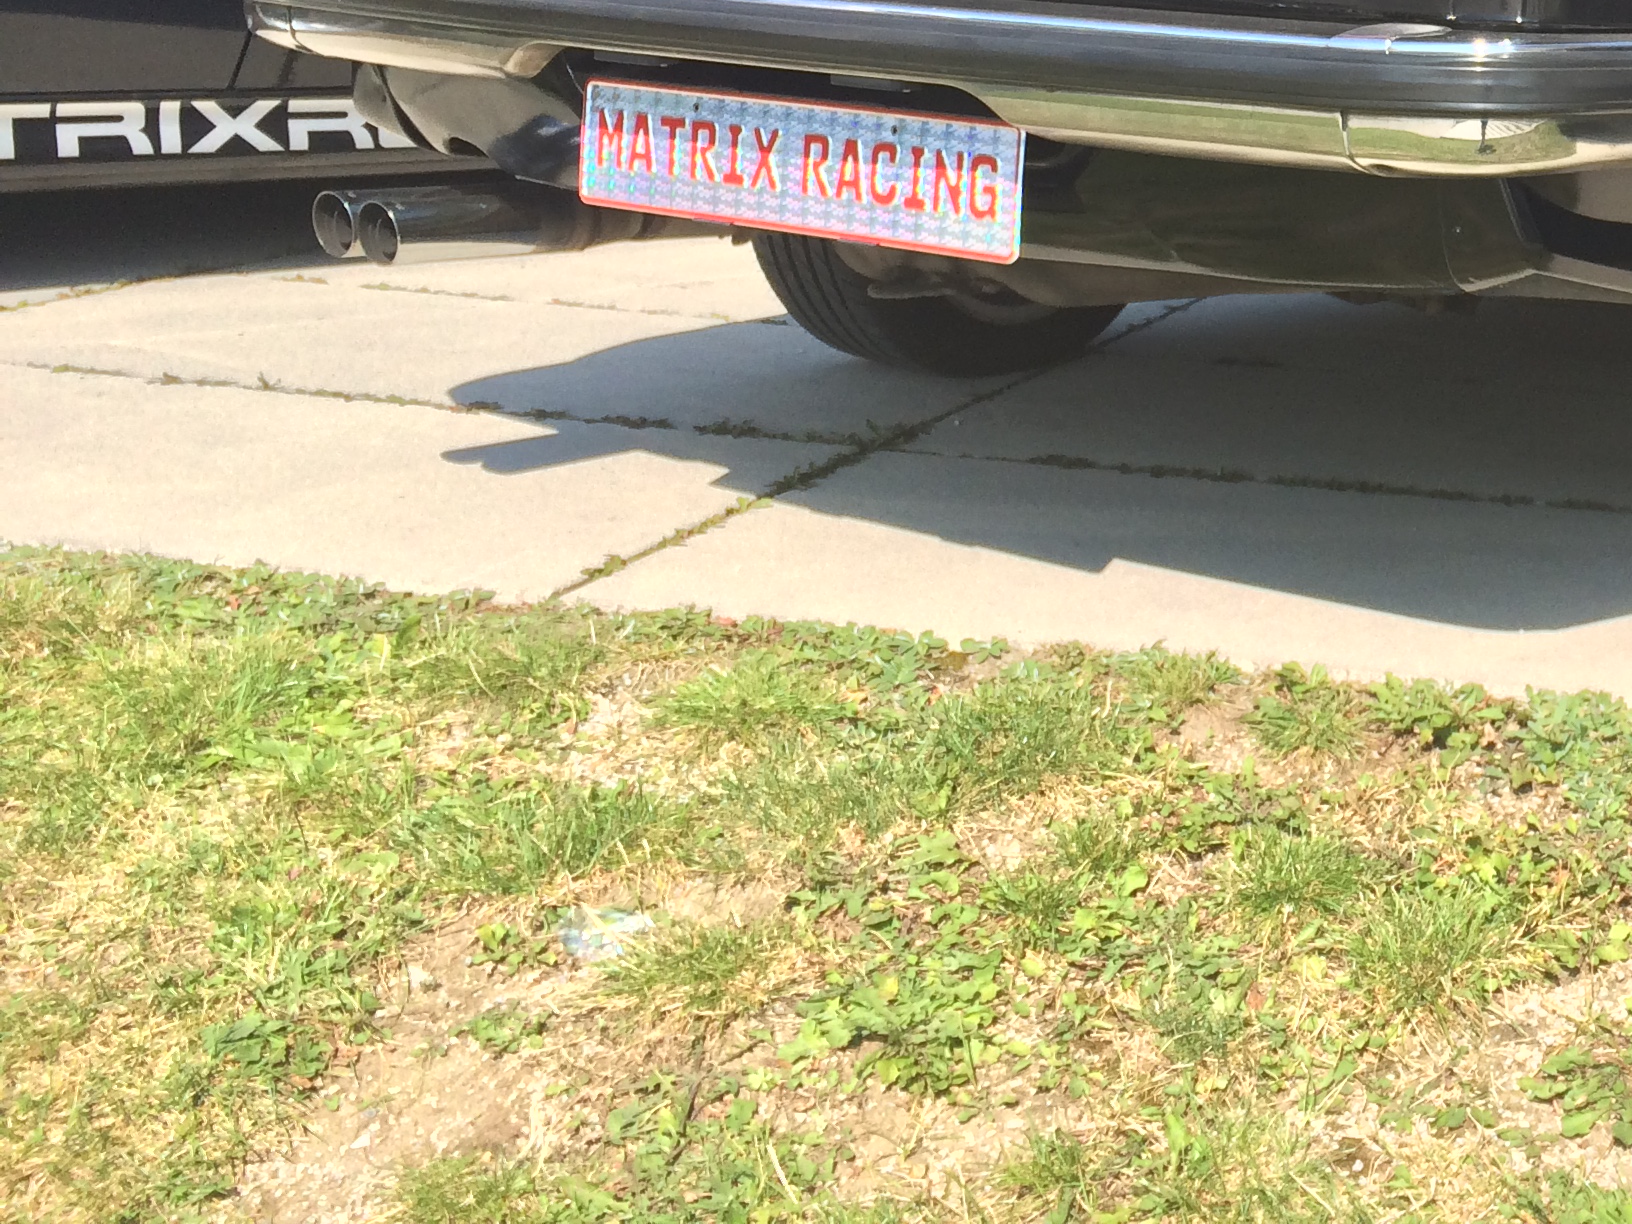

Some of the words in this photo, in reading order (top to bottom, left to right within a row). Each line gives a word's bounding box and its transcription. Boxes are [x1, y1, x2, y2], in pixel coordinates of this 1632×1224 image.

[0, 98, 422, 161] TRIXR
[598, 108, 781, 194] MATRIX
[801, 133, 999, 220] RACING
